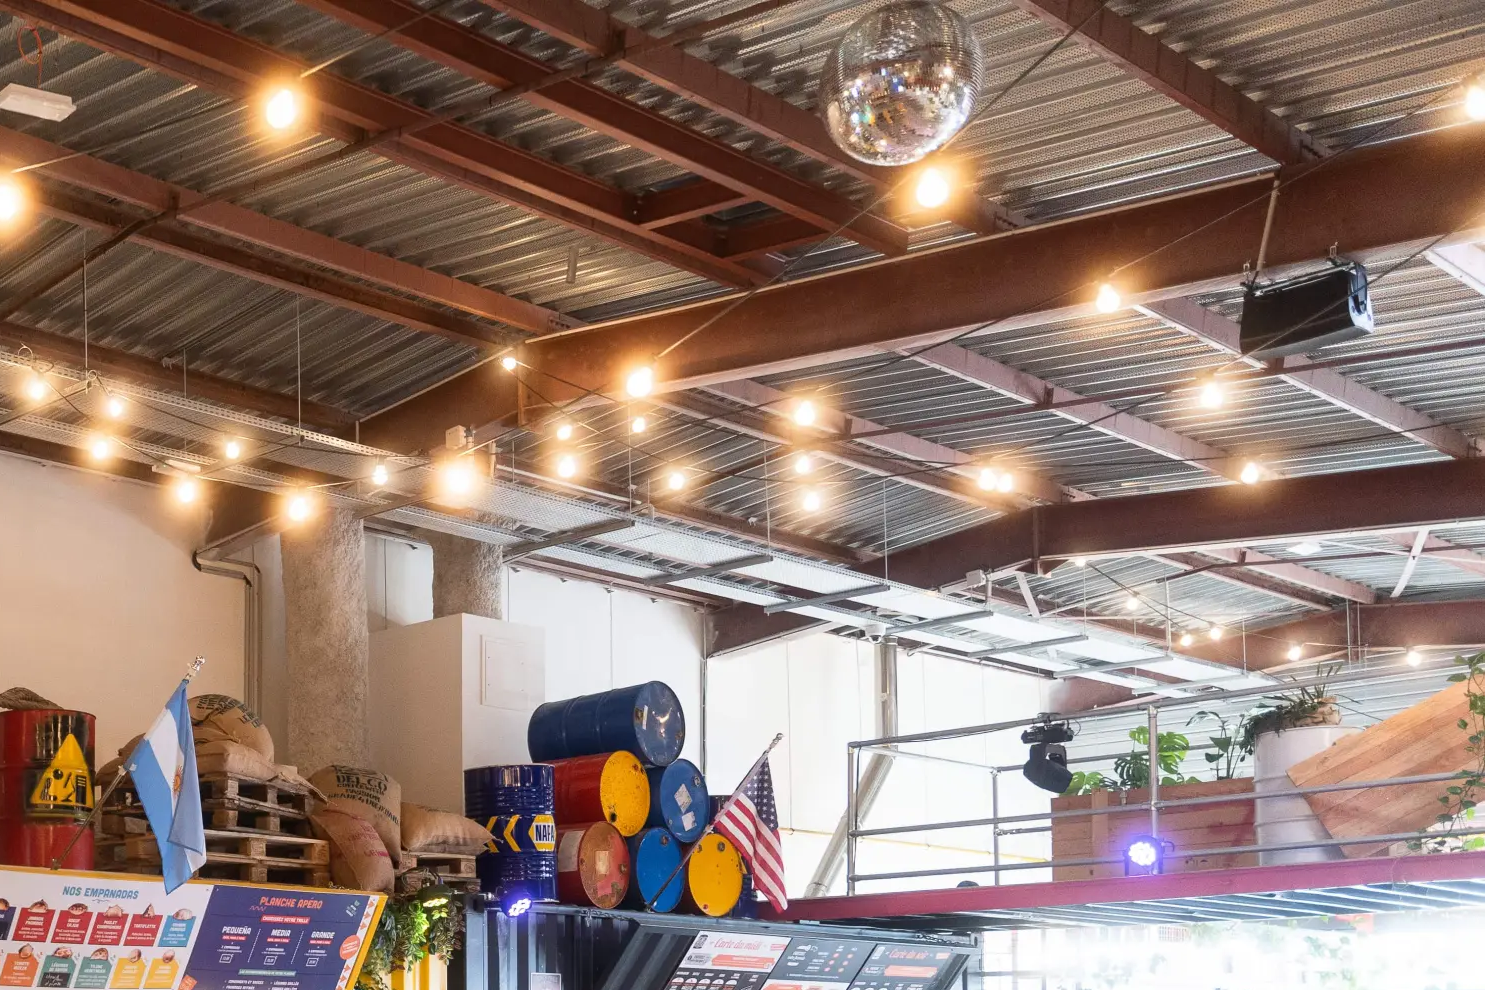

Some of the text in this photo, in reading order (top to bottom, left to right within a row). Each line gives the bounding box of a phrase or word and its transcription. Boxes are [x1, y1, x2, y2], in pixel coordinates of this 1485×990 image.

[62, 886, 139, 900] NOS EMPANADAS
[260, 896, 323, 910] PLANCHE APÉRO
[222, 926, 252, 935] PEQUEÑA
[271, 929, 291, 937] MEDIA
[311, 931, 335, 939] GRANDE
